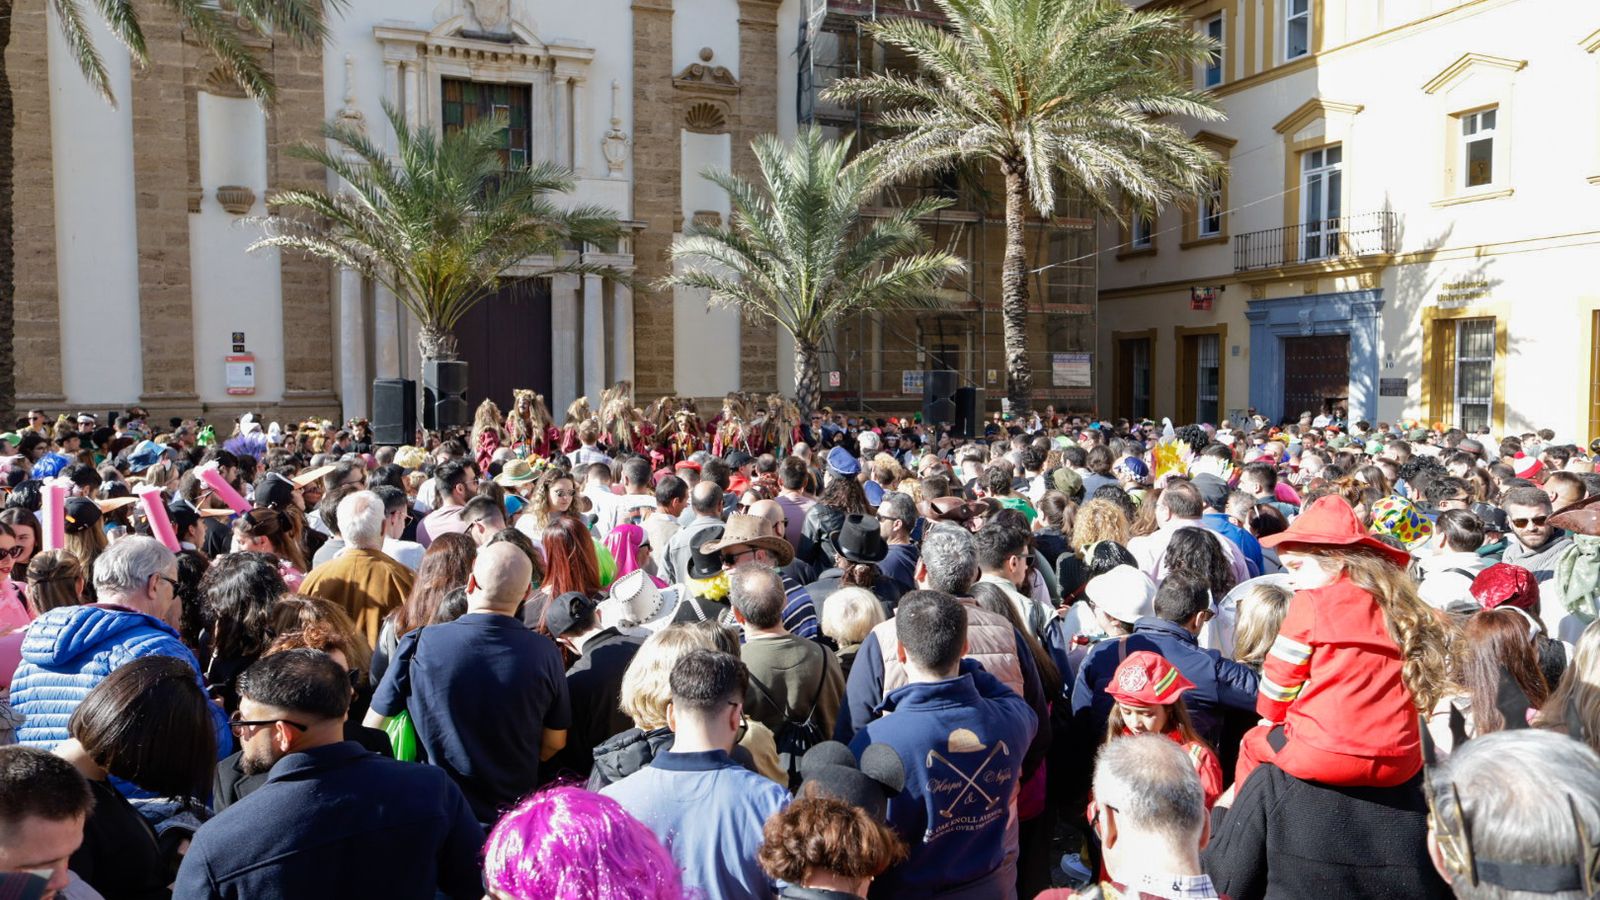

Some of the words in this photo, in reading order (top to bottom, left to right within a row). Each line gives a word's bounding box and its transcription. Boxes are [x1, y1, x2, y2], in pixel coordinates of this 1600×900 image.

[1442, 281, 1488, 290] Residencia
[1437, 292, 1491, 301] Universitar
[964, 792, 977, 804] &
[955, 824, 975, 832] OVER
